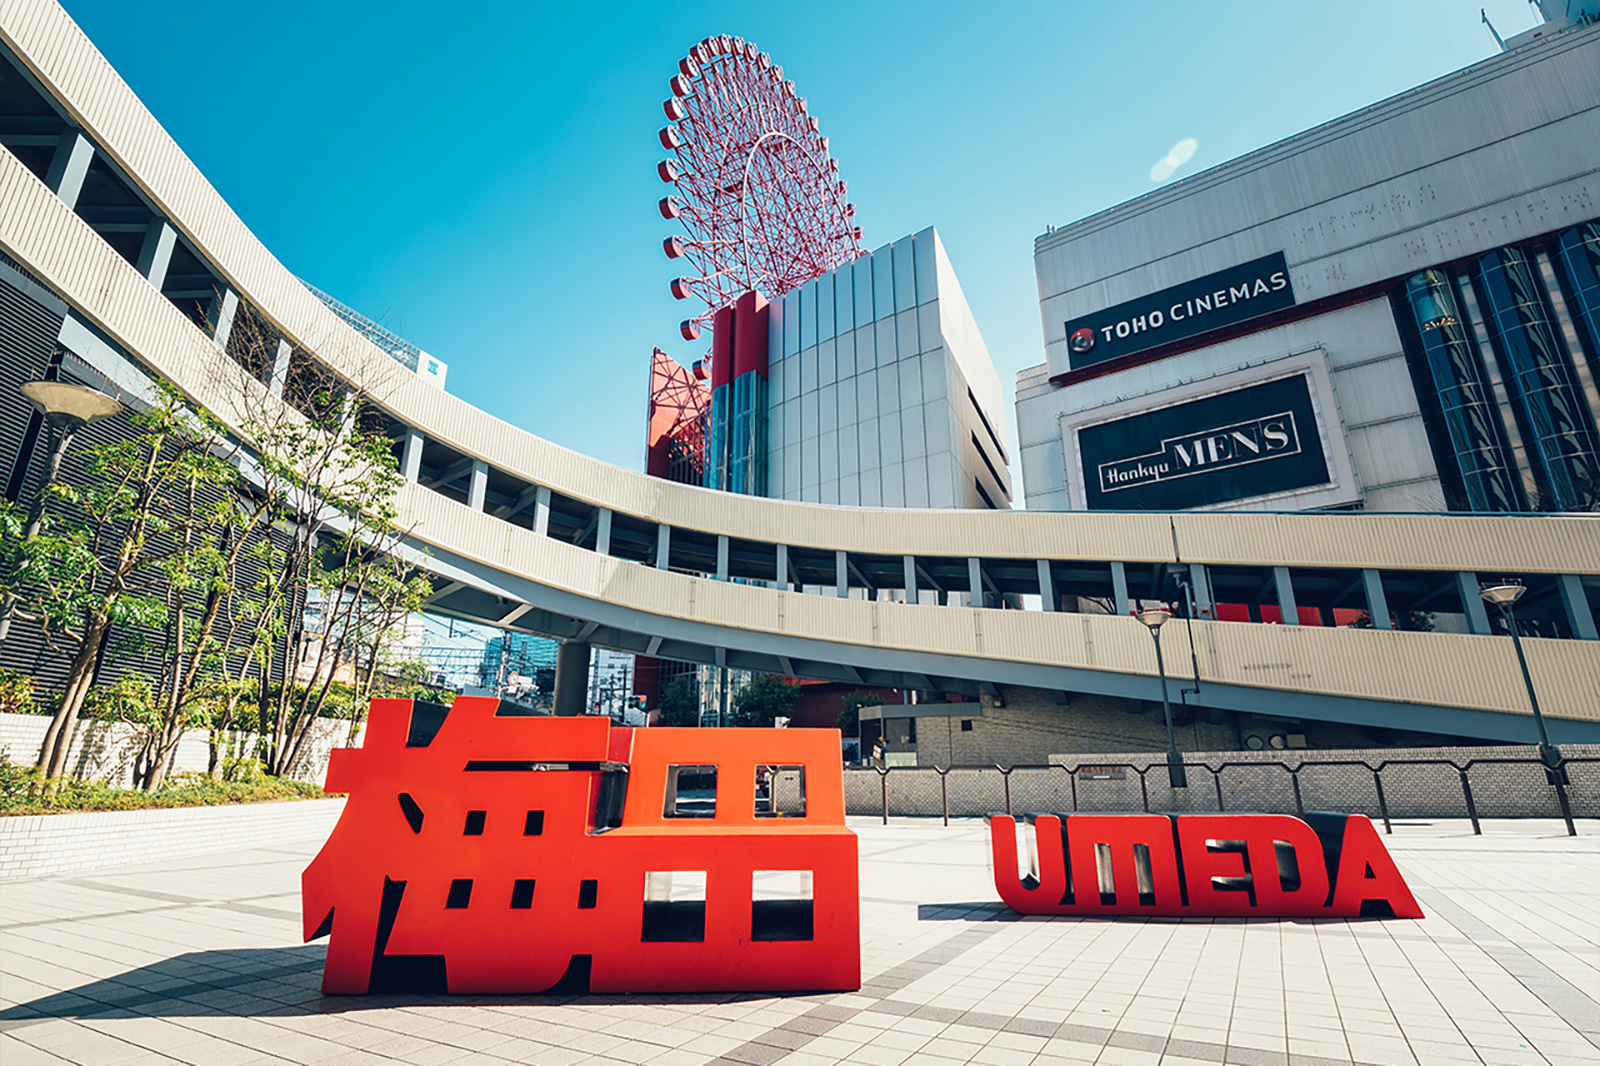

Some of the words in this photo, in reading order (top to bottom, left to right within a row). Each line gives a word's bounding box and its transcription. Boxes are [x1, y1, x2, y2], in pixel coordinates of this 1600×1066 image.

[1101, 311, 1164, 342] TOHO
[1170, 272, 1287, 321] CINEMAS
[1106, 462, 1169, 483] Hankyu
[301, 695, 862, 994] 梅田
[989, 813, 1426, 919] UMEDA
